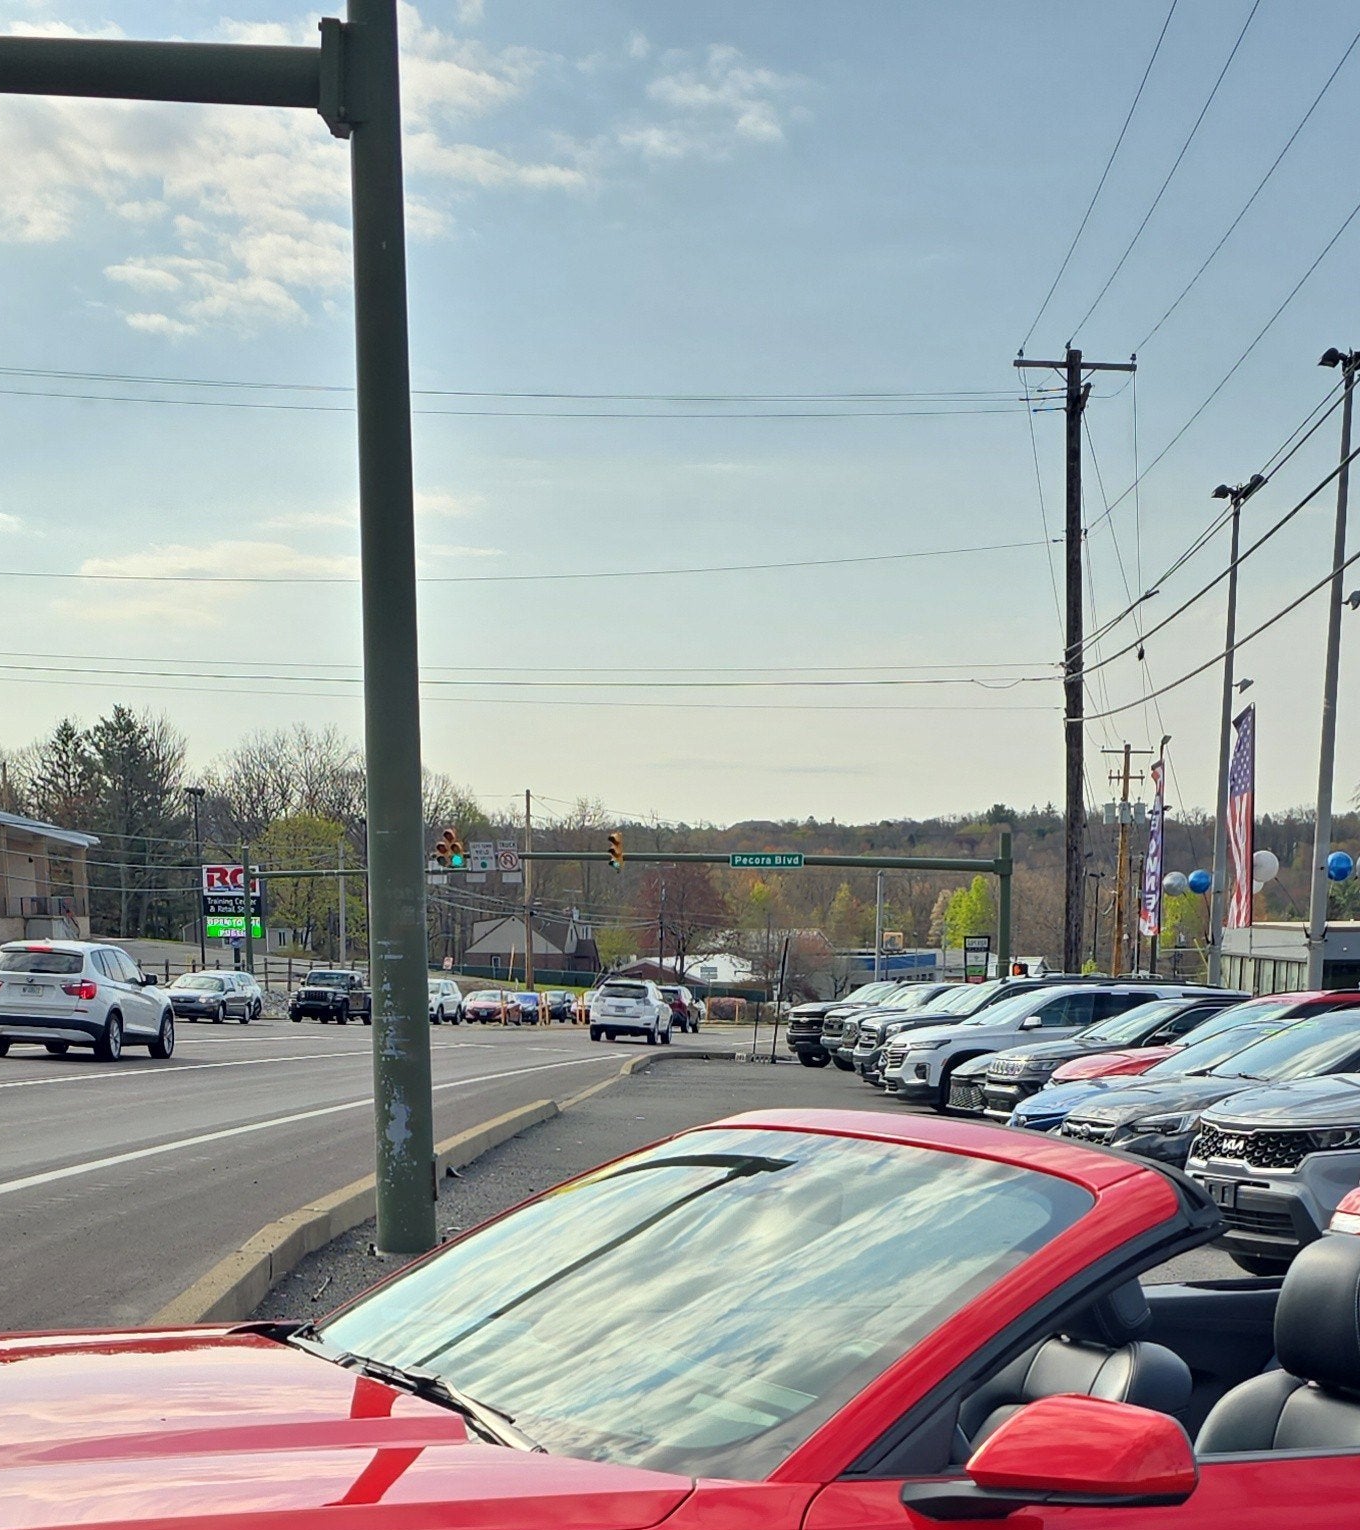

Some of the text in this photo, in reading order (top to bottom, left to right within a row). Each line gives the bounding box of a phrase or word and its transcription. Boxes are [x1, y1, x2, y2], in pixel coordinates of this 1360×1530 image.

[734, 855, 799, 865] Pecora Blvd
[207, 897, 234, 906] Training
